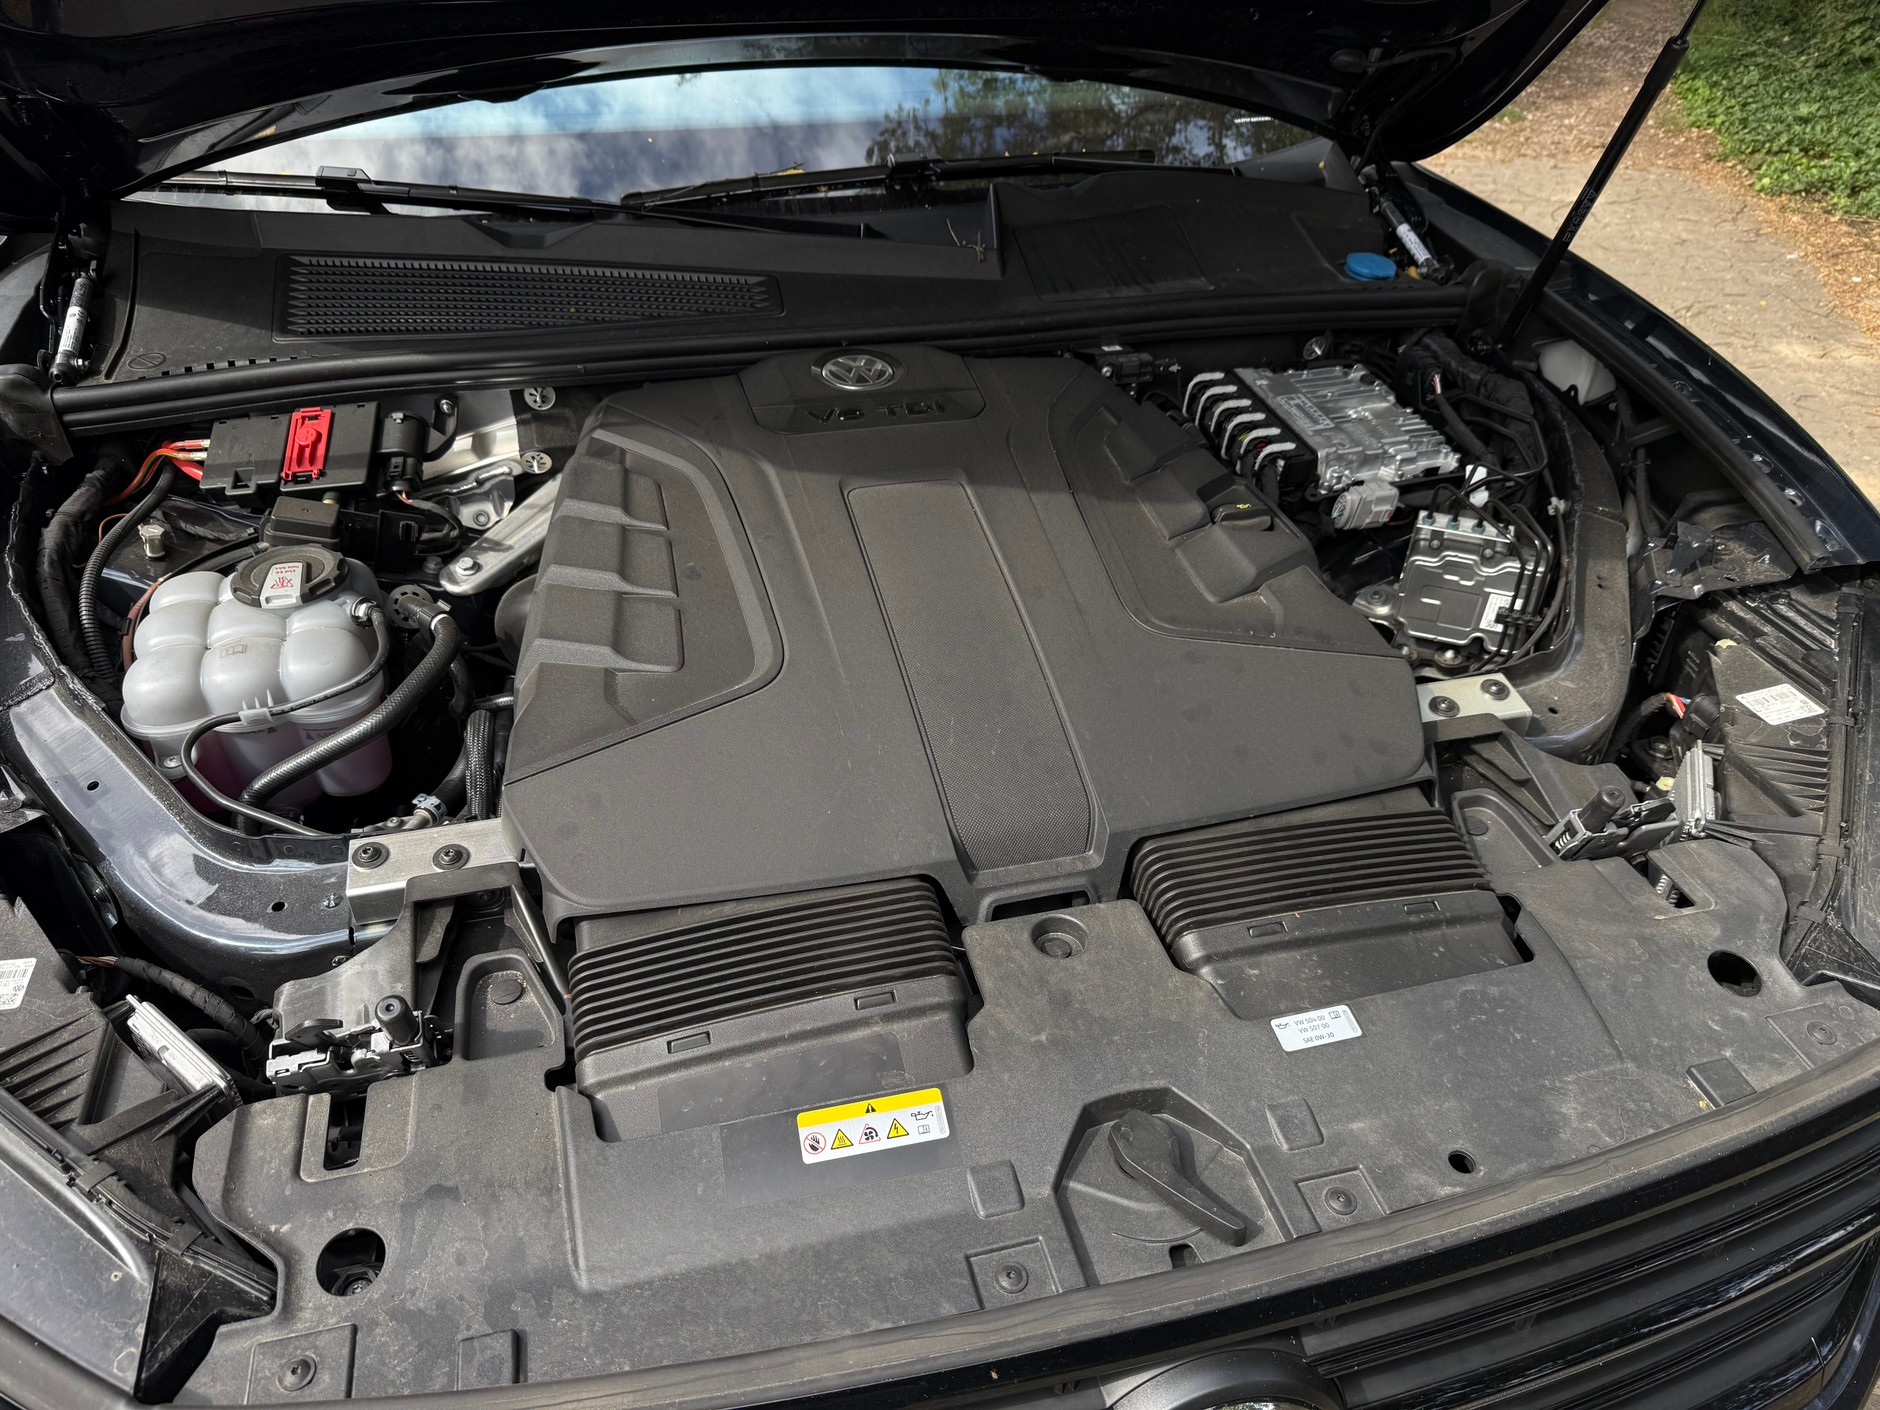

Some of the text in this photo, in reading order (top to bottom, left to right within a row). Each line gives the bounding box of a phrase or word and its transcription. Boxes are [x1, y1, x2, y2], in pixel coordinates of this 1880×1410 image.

[877, 401, 944, 417] TDI
[1309, 1024, 1320, 1032] 507
[1314, 1032, 1335, 1041] 0W-30
